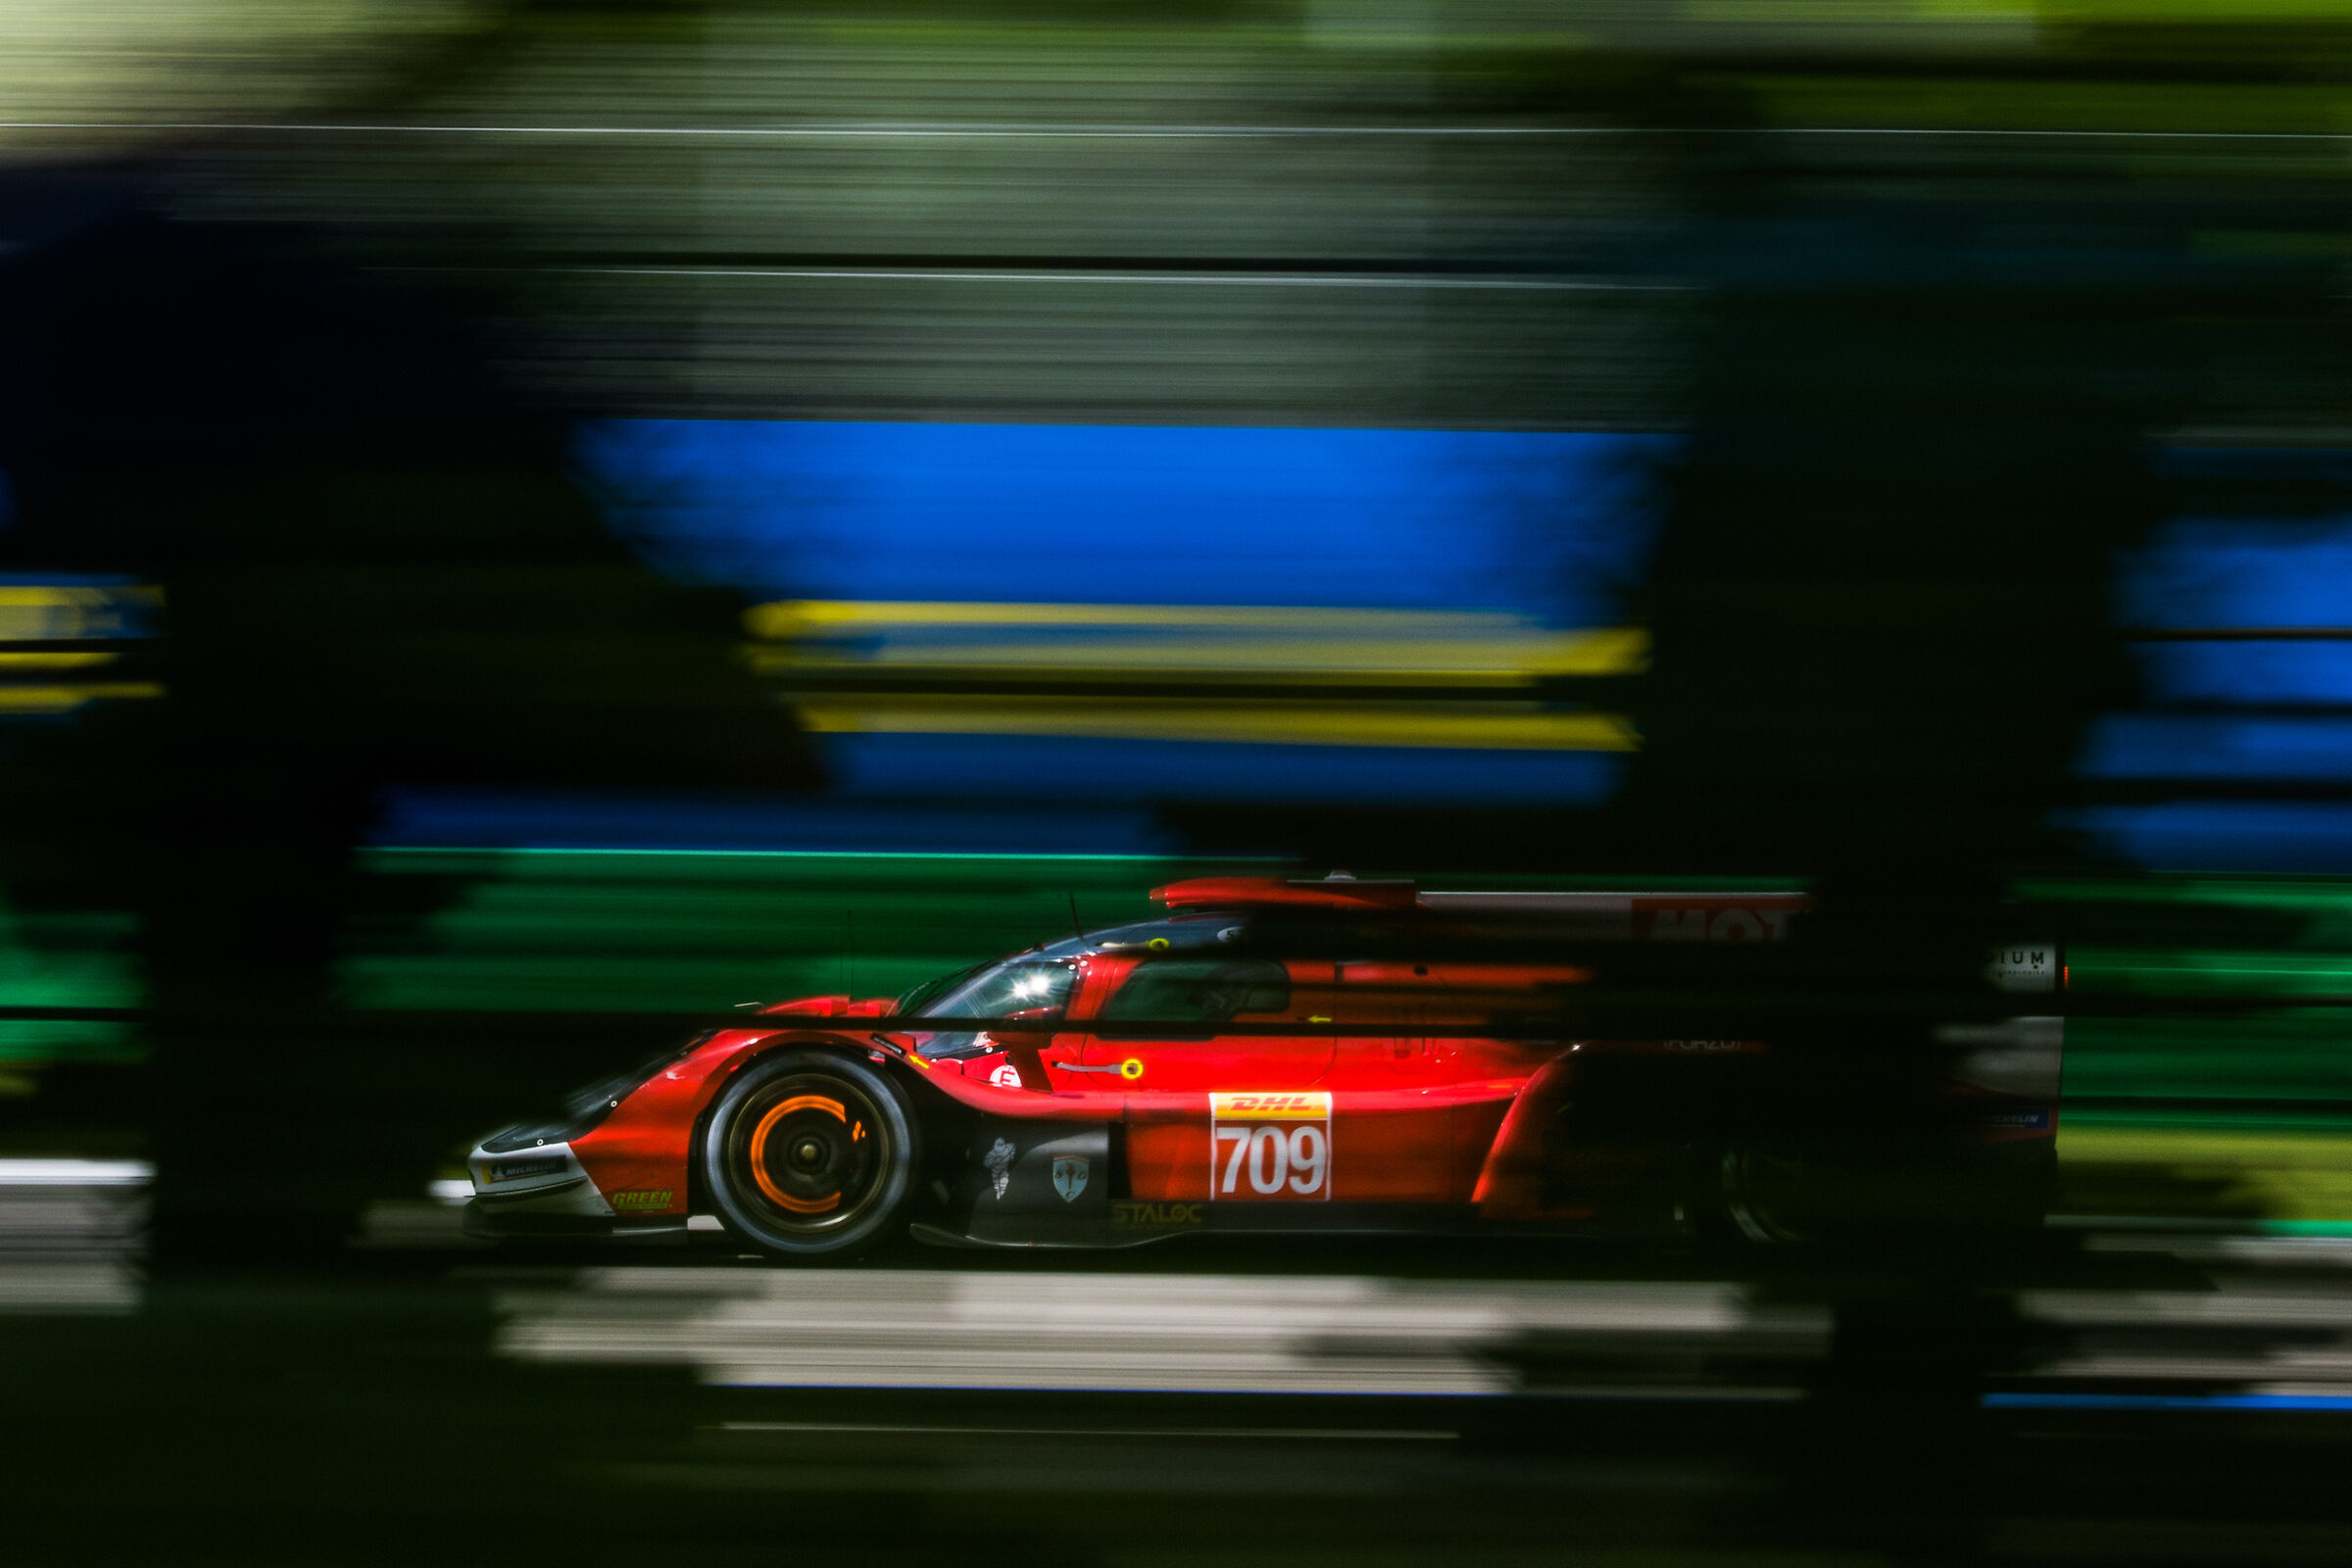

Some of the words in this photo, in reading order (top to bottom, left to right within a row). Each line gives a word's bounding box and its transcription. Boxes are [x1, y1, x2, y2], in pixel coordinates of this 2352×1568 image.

[1230, 1097, 1312, 1110] DHL
[1216, 1126, 1326, 1195] 709
[612, 1192, 673, 1207] GREEN
[1113, 1203, 1204, 1223] STALOC
